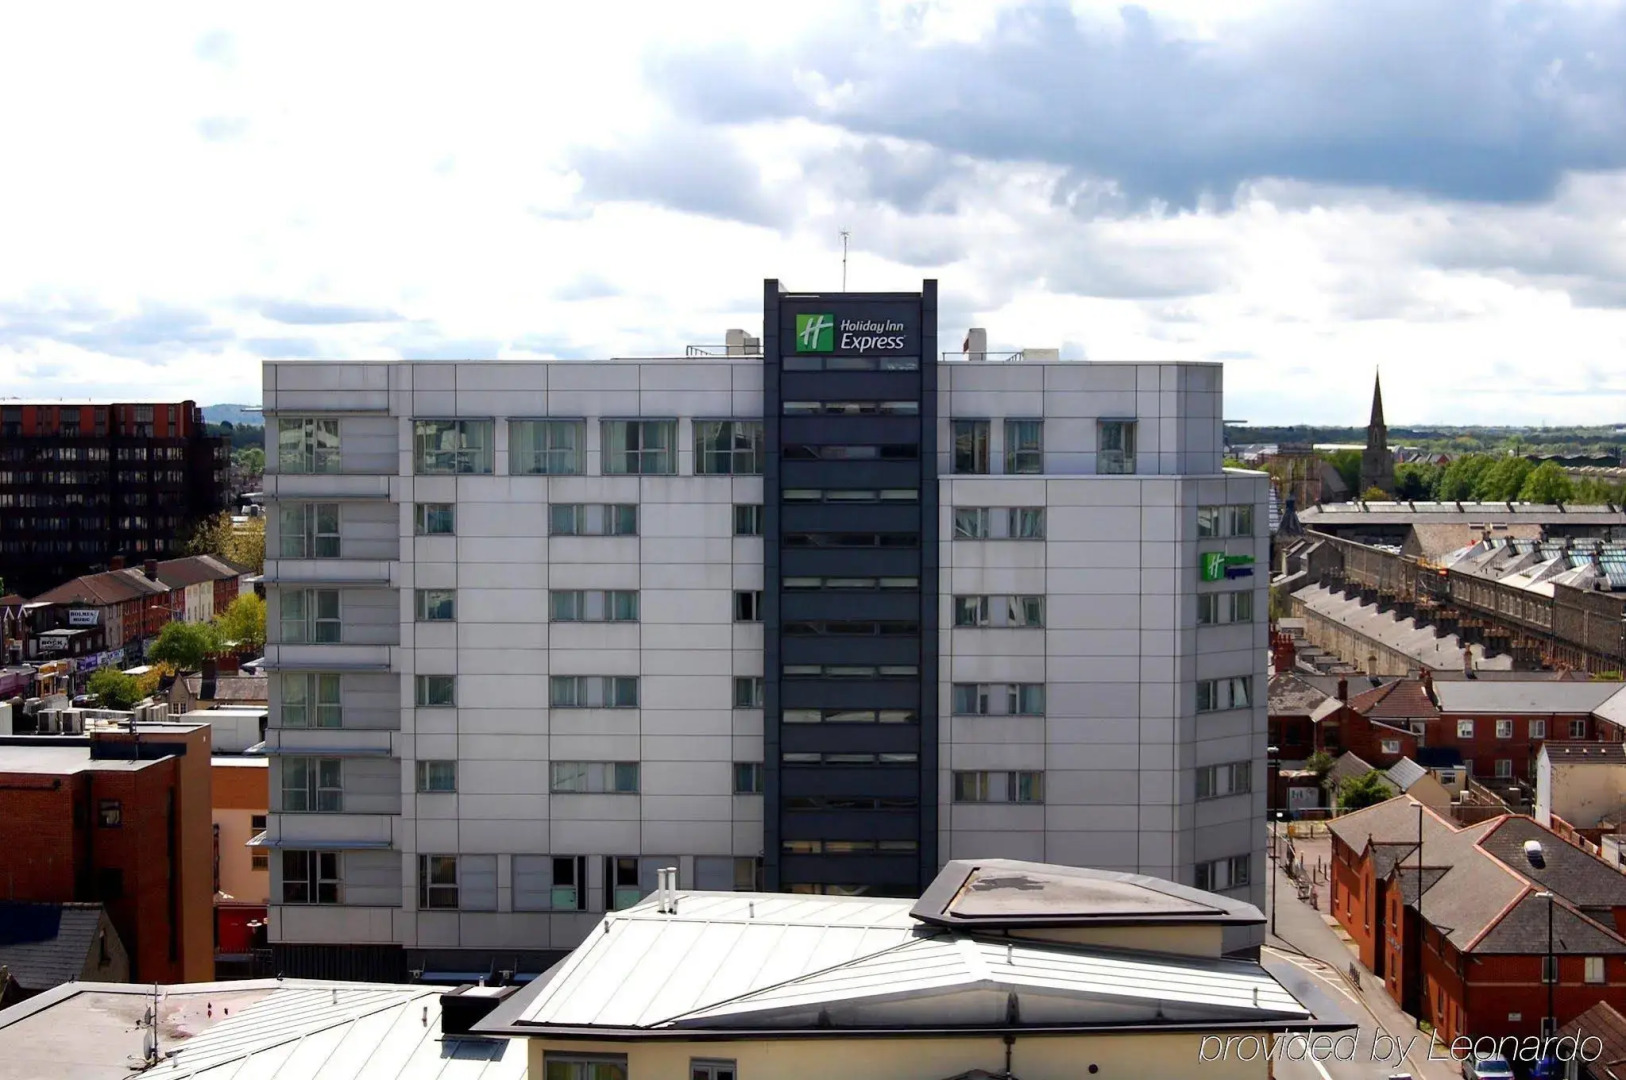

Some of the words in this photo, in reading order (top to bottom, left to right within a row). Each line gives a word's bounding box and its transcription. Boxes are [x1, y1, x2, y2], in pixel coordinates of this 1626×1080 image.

[840, 319, 885, 333] Holiday
[885, 319, 904, 331] Inn
[840, 333, 904, 353] Express
